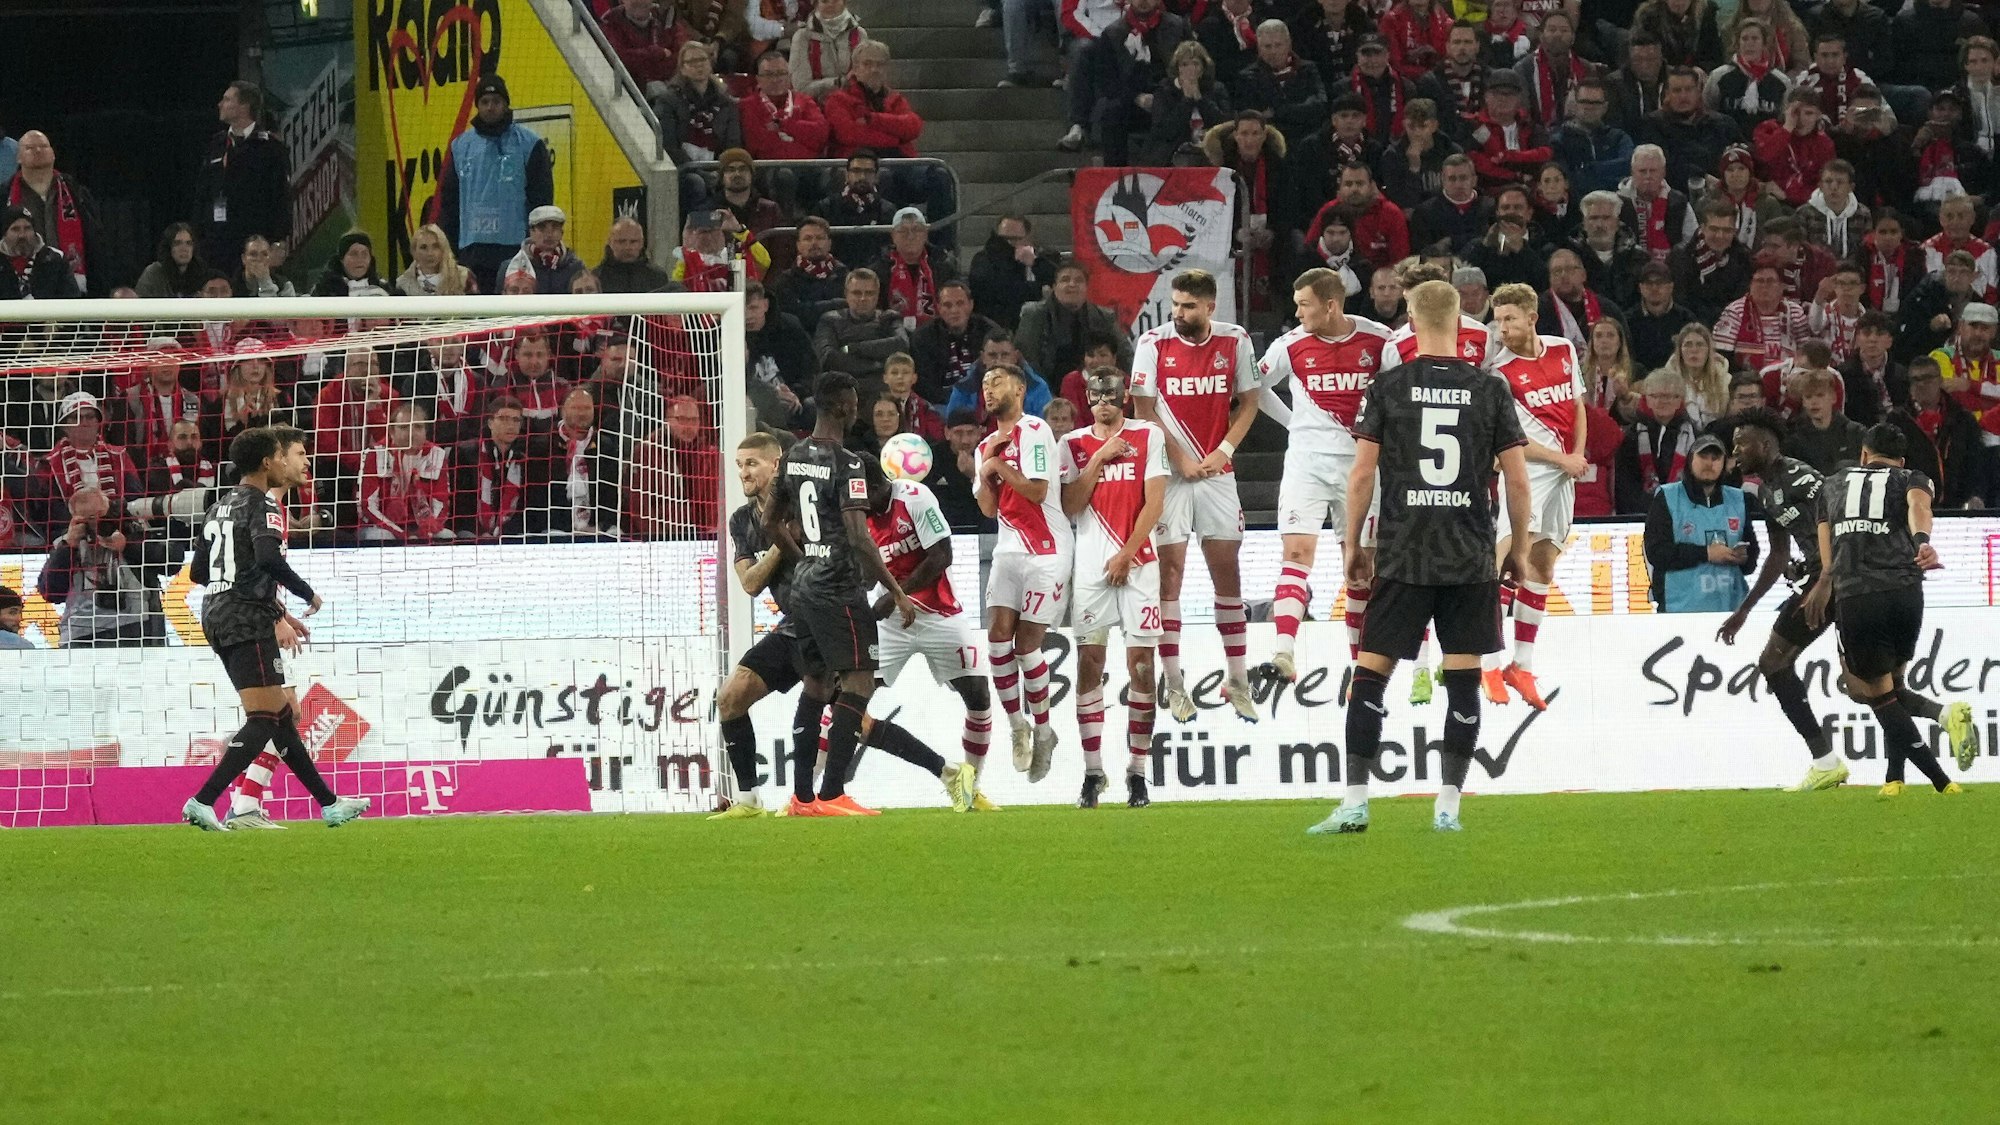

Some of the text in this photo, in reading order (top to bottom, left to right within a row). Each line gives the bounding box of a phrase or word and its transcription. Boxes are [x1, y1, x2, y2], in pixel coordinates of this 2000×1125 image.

[286, 152, 338, 256] ANSHOP
[1166, 375, 1228, 396] REWE
[1306, 372, 1370, 392] REWE
[1411, 386, 1472, 406] BAKKER
[1419, 407, 1461, 487] 5
[1845, 472, 1890, 520] 11
[799, 480, 821, 542] 6
[927, 508, 943, 533] DEVK
[1238, 509, 1246, 533] 5
[203, 520, 236, 582] 21
[878, 533, 921, 563] EWE
[1022, 590, 1046, 616] 37
[1139, 606, 1161, 630] 28
[955, 646, 979, 669] 17
[1821, 711, 1888, 760] fü
[1151, 726, 1445, 787] für mch
